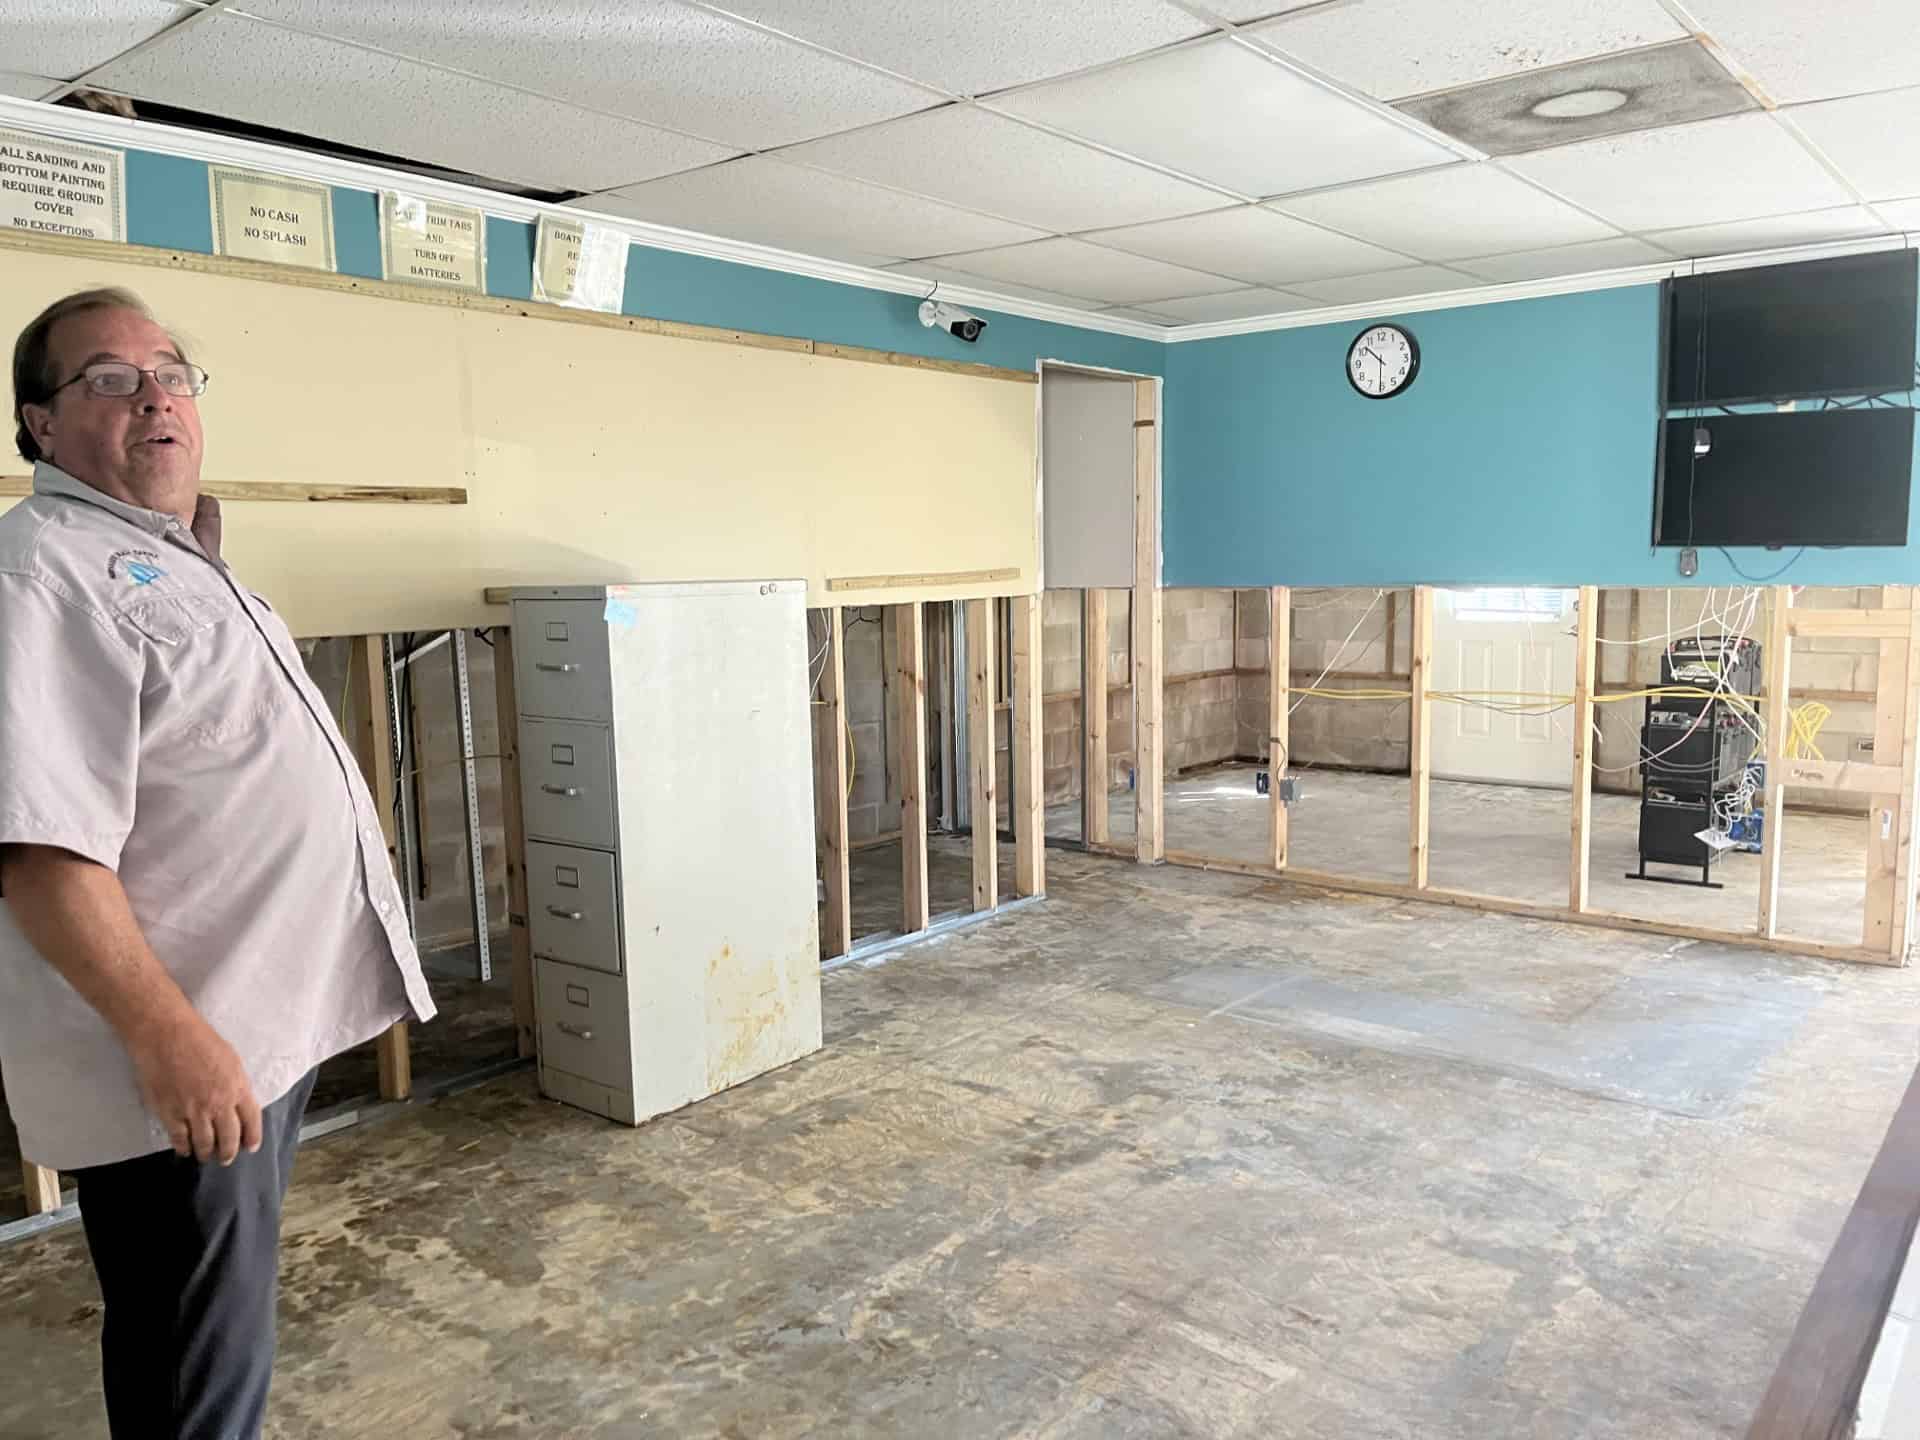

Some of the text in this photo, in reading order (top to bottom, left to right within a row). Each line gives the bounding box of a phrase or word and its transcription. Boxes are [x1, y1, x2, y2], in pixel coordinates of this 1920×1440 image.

[0, 146, 105, 174] ALL SANDING AND
[0, 163, 105, 190] BOTTOM PAINTING
[2, 179, 104, 205] REQUIRE GROUND
[34, 201, 74, 216] COVER
[250, 206, 299, 224] NO CASH
[13, 217, 95, 238] NO EXCEPTIONS
[426, 215, 472, 231] TRIM TABS
[244, 227, 306, 246] NO SPLASH
[425, 233, 444, 244] AND
[415, 248, 456, 262] TURN OFF
[410, 265, 461, 281] BATTERIES
[1367, 336, 1373, 346] 11
[1377, 331, 1386, 341] 12
[1359, 347, 1368, 357] 10
[1400, 342, 1405, 351] 2
[1403, 353, 1409, 363] 3
[1355, 360, 1362, 368] 9
[1399, 366, 1405, 375] 4
[1360, 372, 1365, 381] 8
[1390, 377, 1397, 386] 5
[1367, 380, 1373, 389] 7
